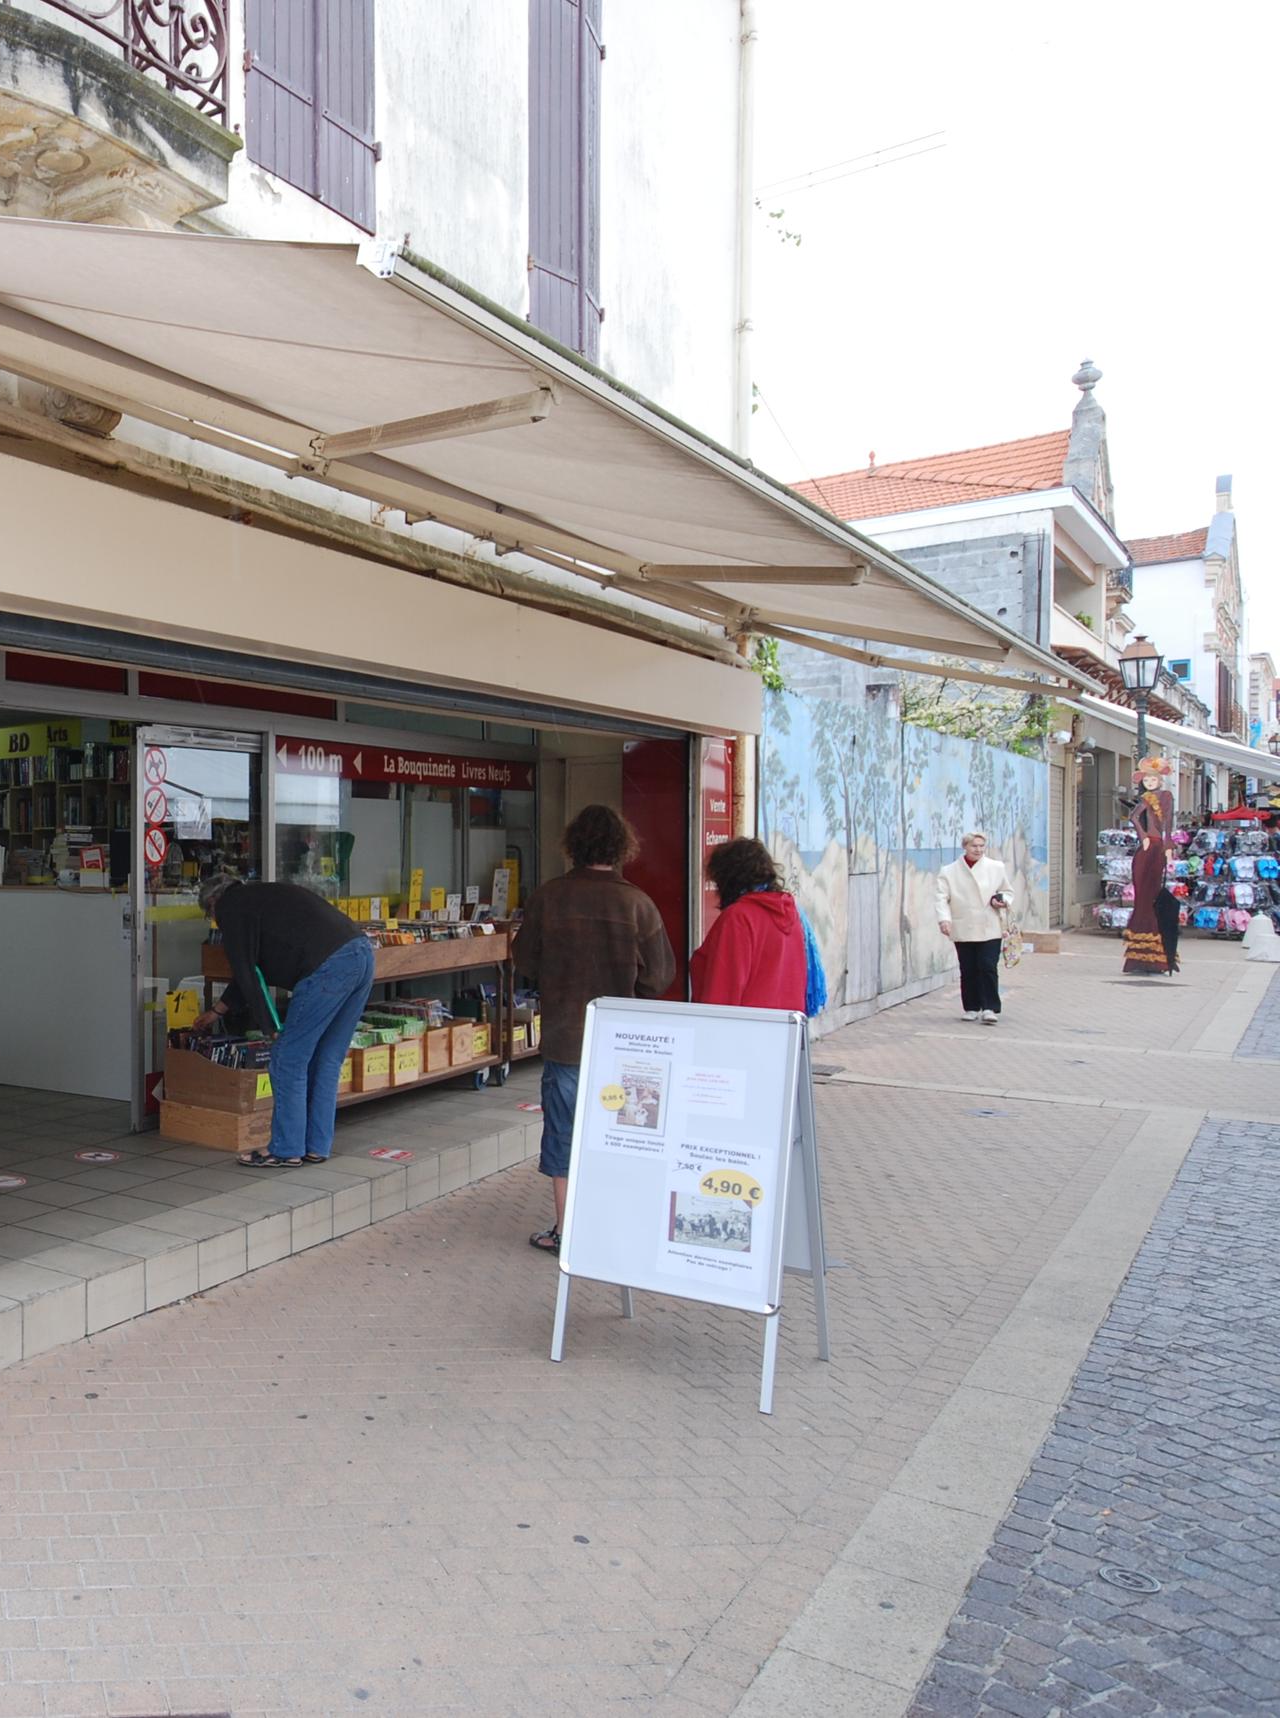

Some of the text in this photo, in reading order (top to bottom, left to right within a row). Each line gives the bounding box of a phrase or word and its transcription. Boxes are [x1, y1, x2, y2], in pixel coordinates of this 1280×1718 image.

[8, 732, 30, 753] BD
[47, 725, 68, 743] Arts
[298, 746, 343, 773] 100 m
[383, 755, 512, 786] La Bouquinerie Livres Neufs
[709, 799, 726, 813] Vente
[680, 1143, 698, 1152] PRIX
[700, 1146, 756, 1160] EXCEPTIONNEL
[702, 1176, 761, 1200] 4,90 €
